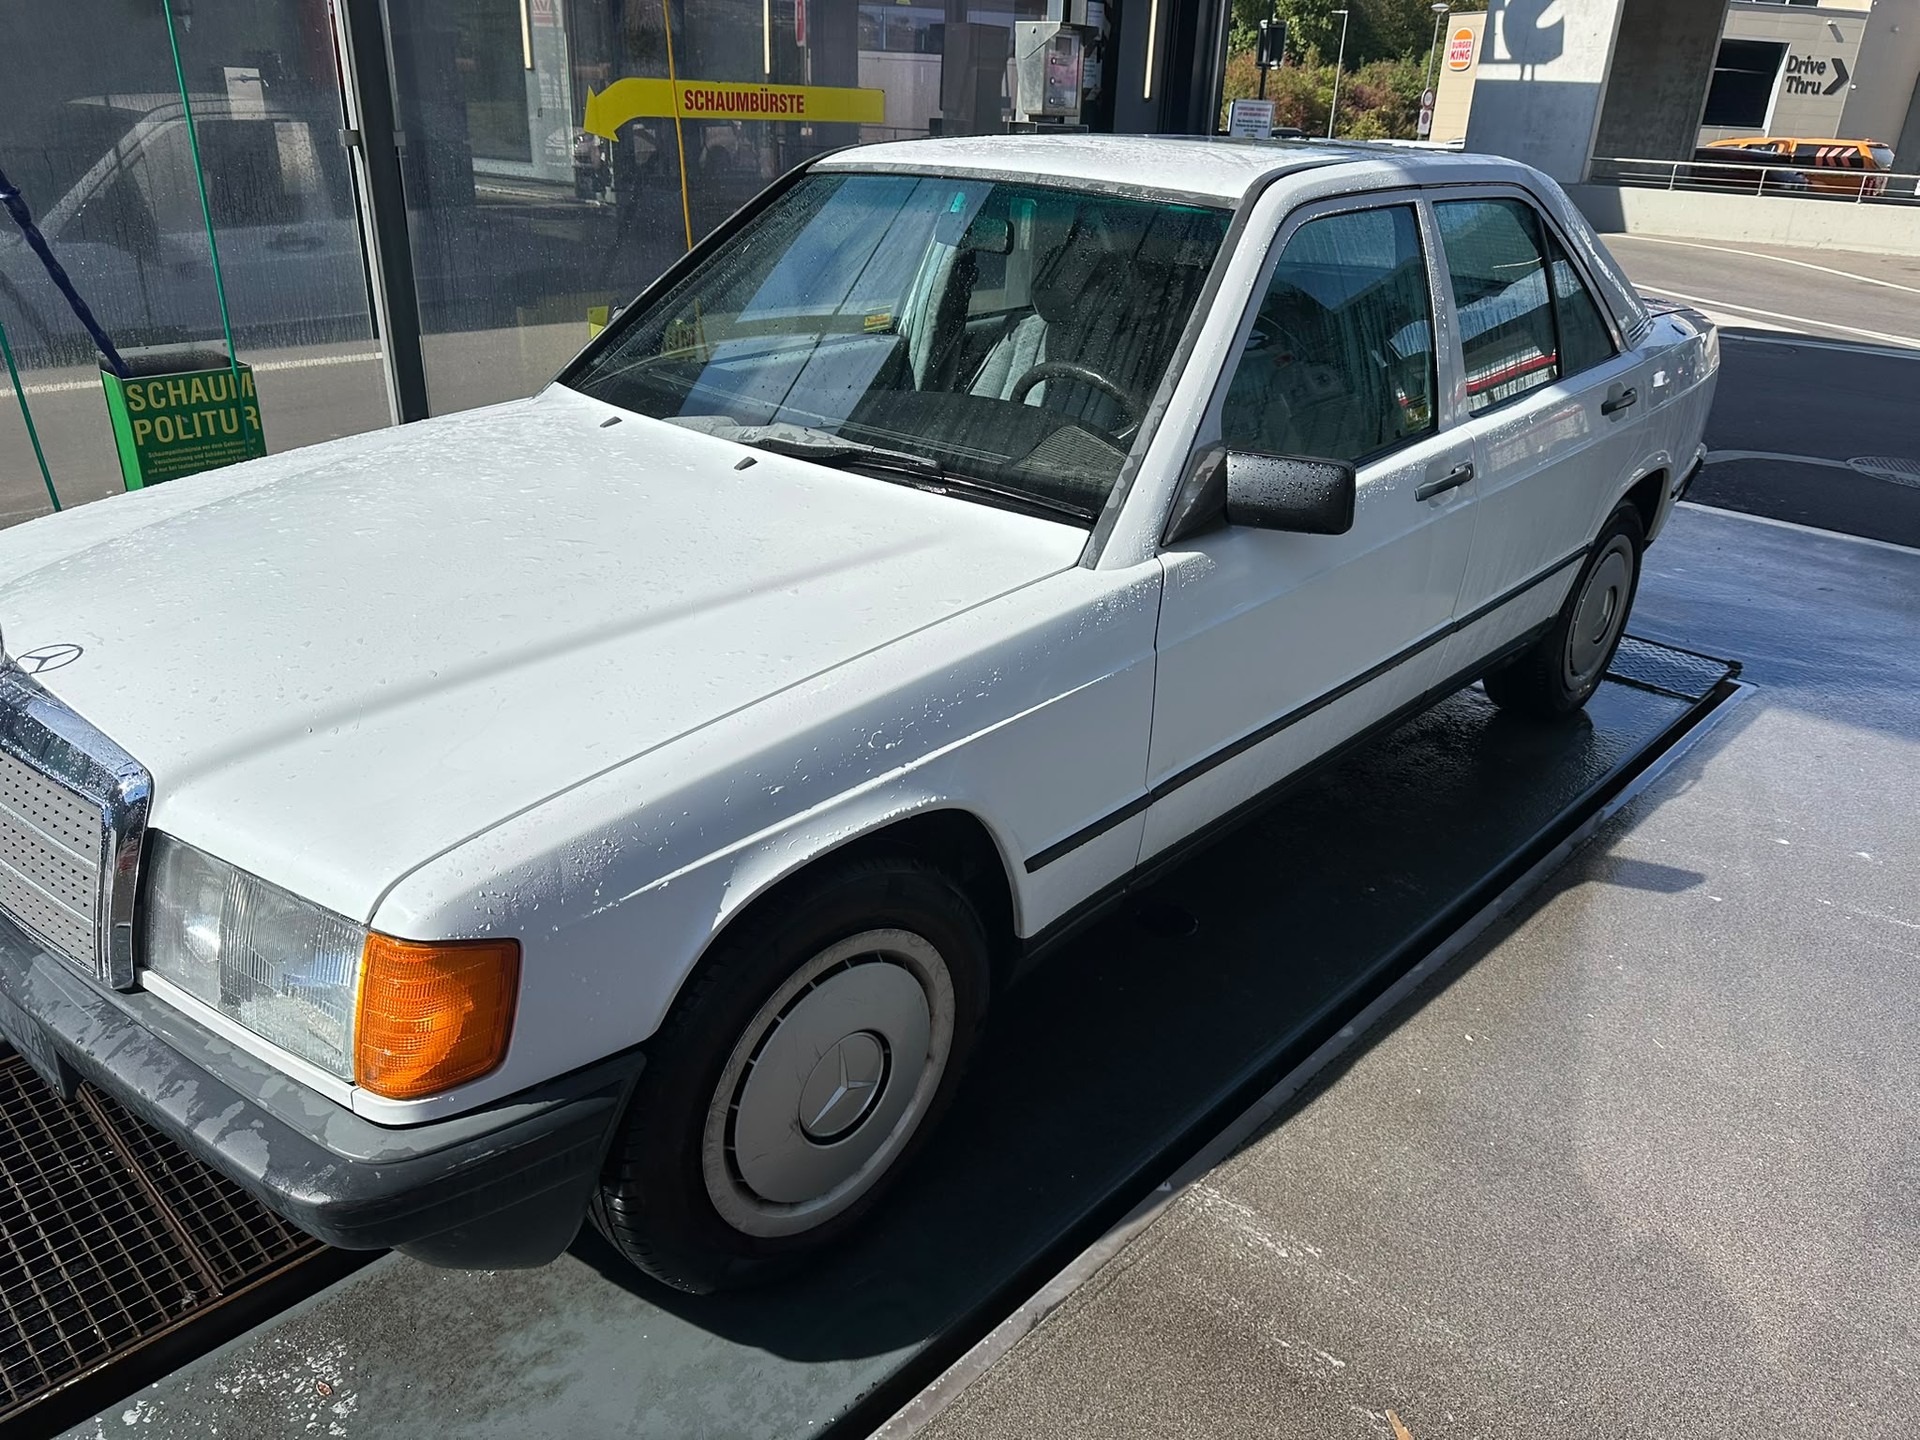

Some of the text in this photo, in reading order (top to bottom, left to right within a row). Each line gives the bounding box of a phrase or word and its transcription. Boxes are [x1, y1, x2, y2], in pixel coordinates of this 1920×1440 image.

[1450, 49, 1471, 60] KING
[1786, 55, 1826, 76] Drive
[1786, 76, 1821, 95] Thru
[684, 88, 804, 113] SCHAUMBÜRSTE
[126, 372, 254, 412] SCHAUM
[133, 405, 260, 446] POLITUR
